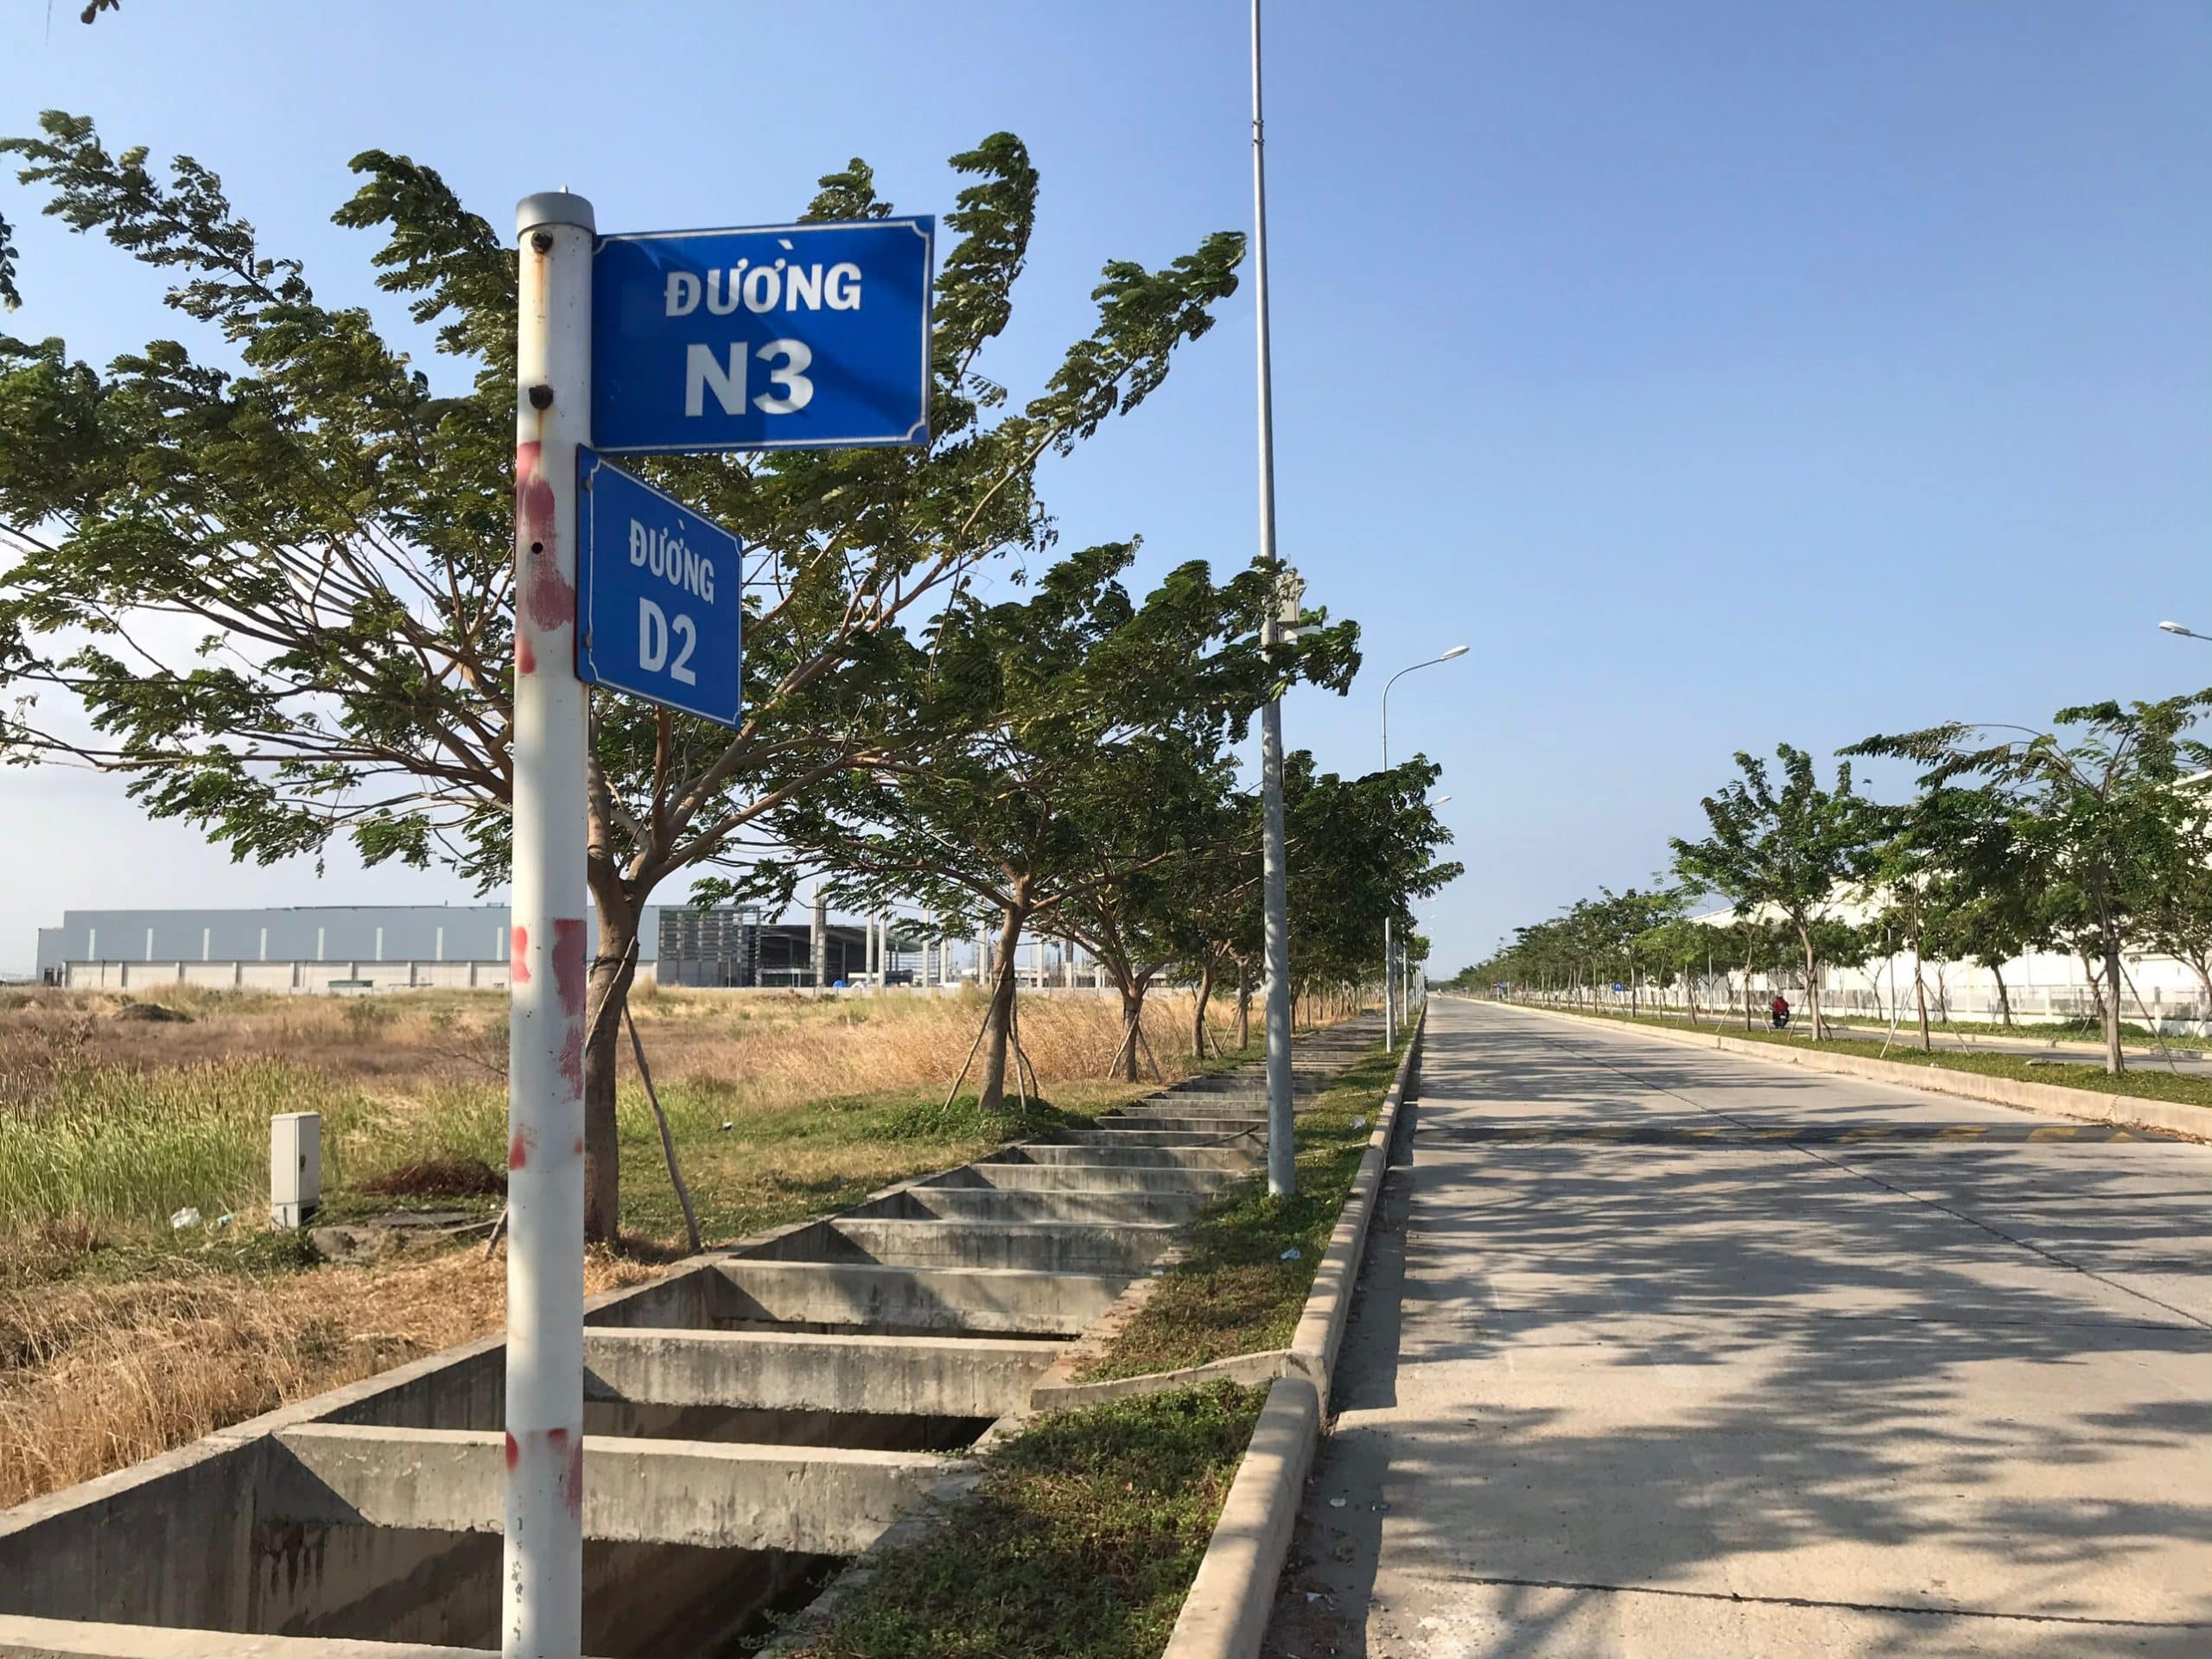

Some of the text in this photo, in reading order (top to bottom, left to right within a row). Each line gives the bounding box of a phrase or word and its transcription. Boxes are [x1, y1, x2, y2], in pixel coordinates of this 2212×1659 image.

[664, 239, 862, 317] ĐƯỜNG
[684, 338, 814, 417] N3
[629, 518, 715, 605] ĐƯỜNG
[639, 597, 696, 687] D2
